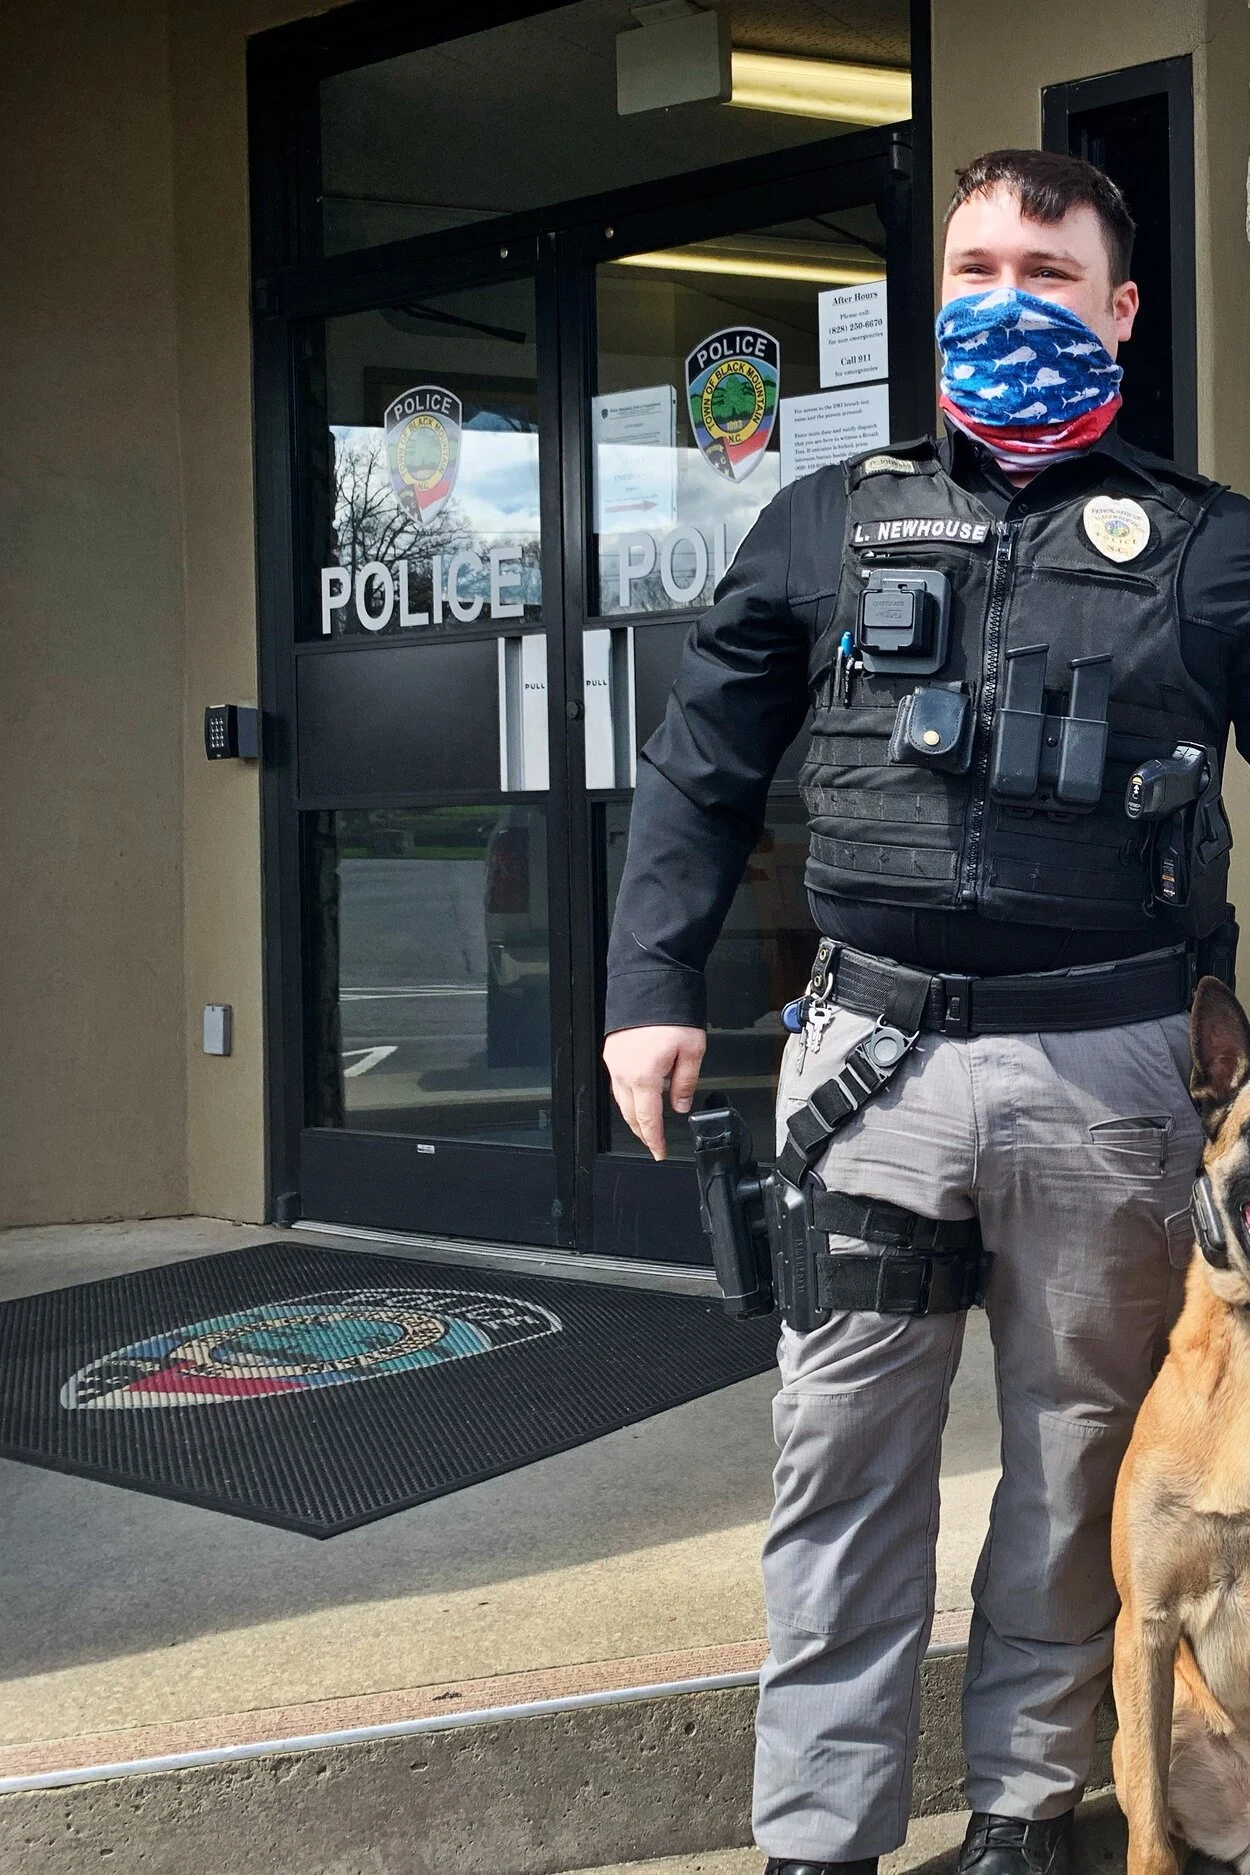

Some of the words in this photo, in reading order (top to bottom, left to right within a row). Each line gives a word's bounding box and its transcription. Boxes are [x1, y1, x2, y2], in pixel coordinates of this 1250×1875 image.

[832, 296, 852, 306] After
[854, 291, 878, 302] Hours
[828, 324, 848, 335] (828)
[697, 335, 768, 369] POLICE
[840, 355, 857, 366] Call
[858, 353, 872, 363] 911
[715, 361, 745, 381] BLACK
[706, 380, 716, 395] OF
[747, 366, 766, 425] MOUNTAIN
[393, 393, 453, 421] POLICE
[703, 398, 715, 432] TOWN
[409, 416, 434, 432] BLACK
[728, 433, 743, 443] N.C.
[854, 525, 870, 543] L.
[877, 519, 988, 541] NEWHOUSE
[320, 545, 525, 635] POLICE
